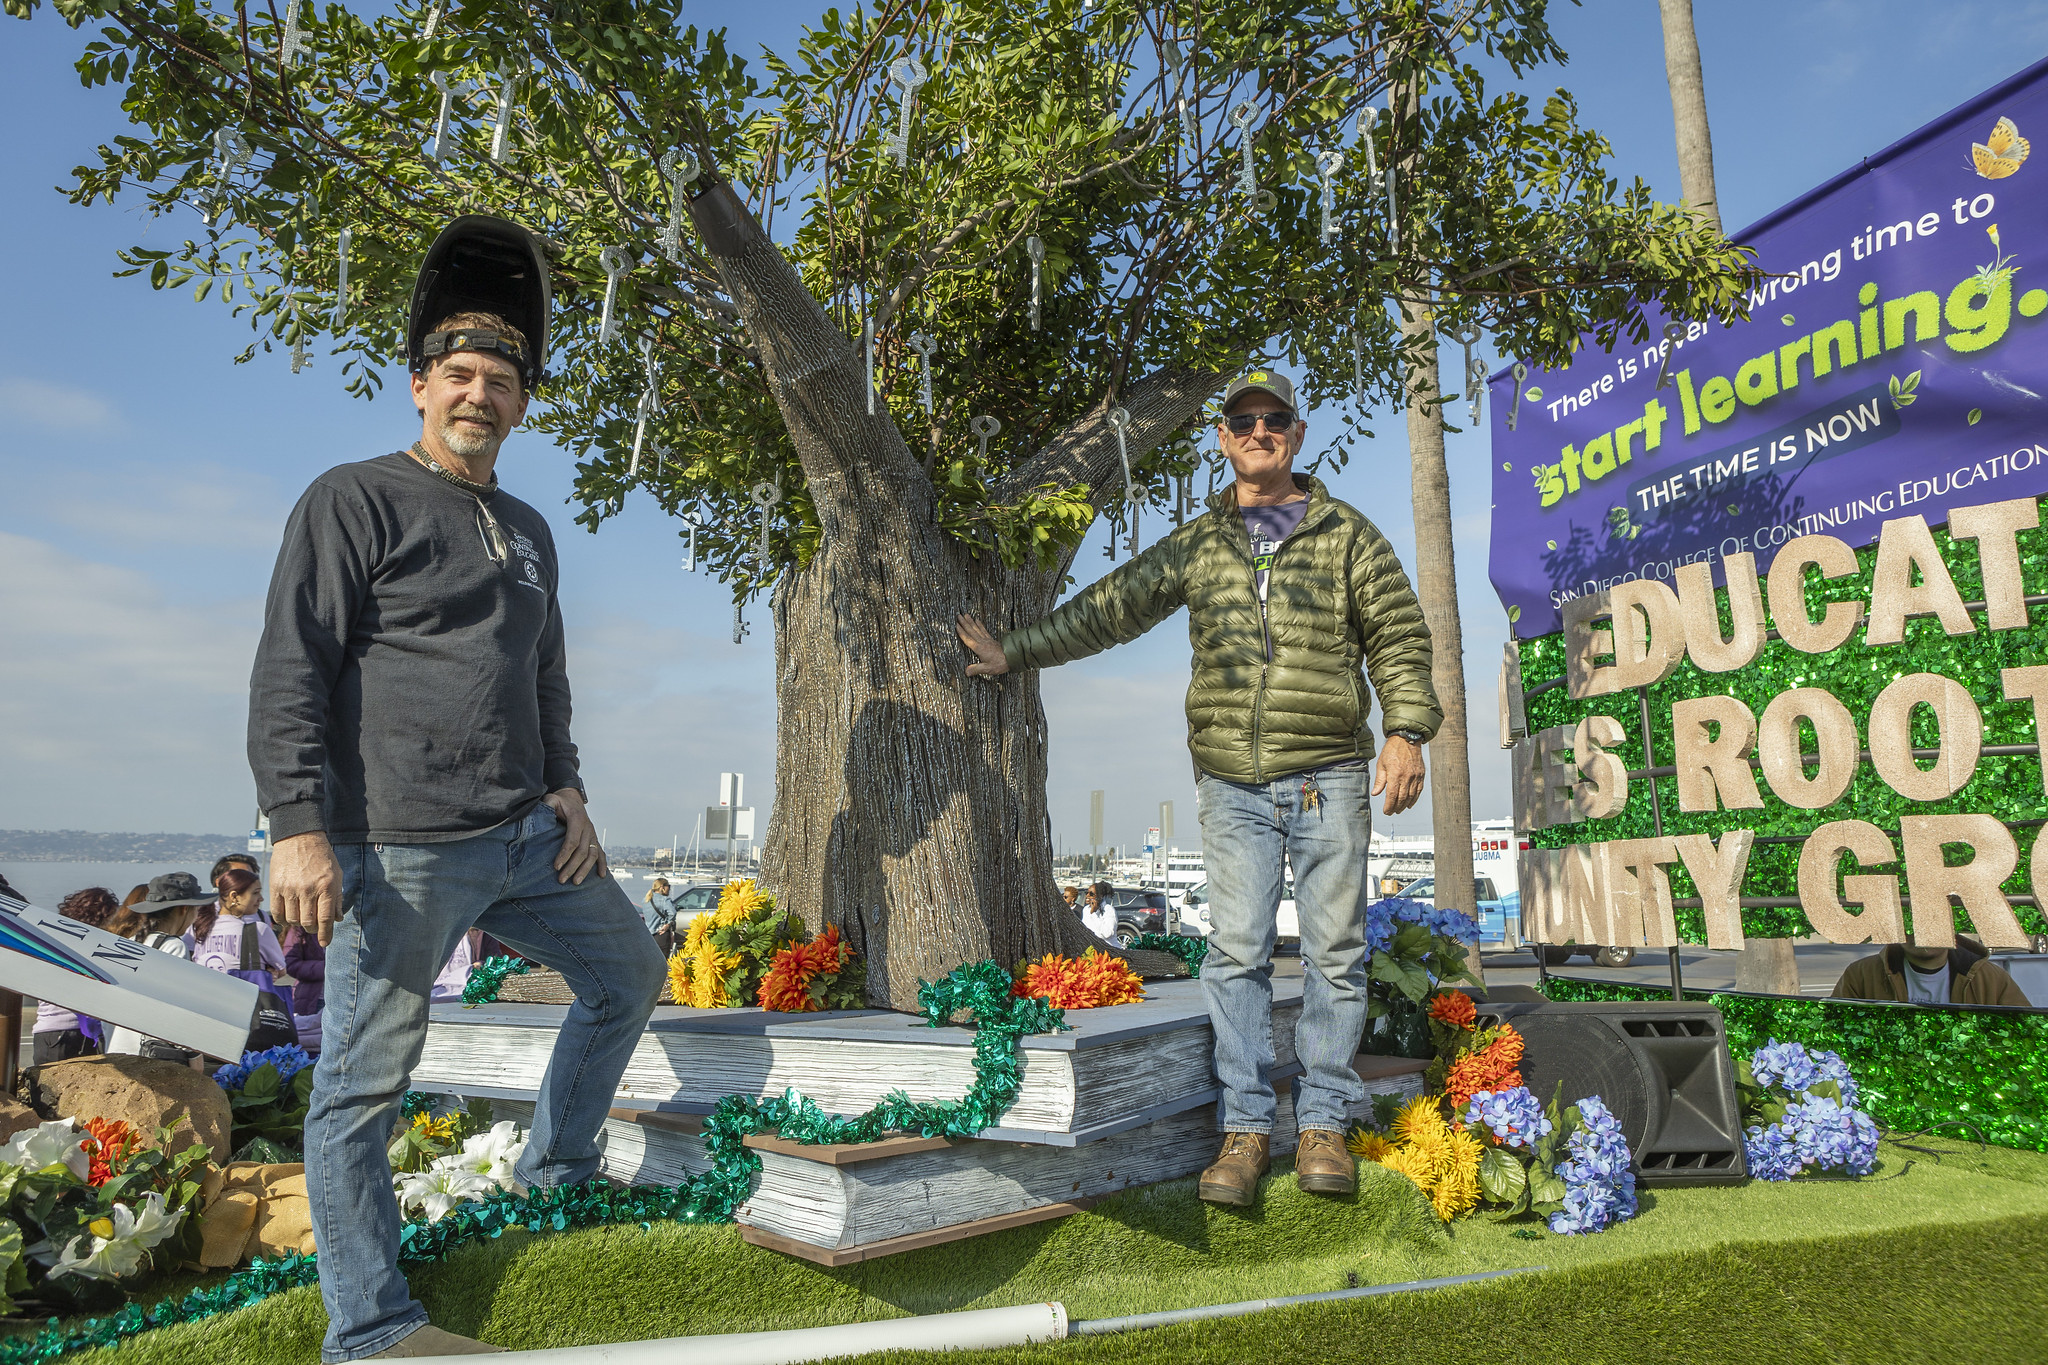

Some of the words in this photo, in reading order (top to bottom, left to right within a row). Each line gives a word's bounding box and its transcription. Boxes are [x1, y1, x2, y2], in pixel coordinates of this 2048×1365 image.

[1541, 397, 1668, 508] start
[1676, 268, 2048, 437] learning.
[1546, 374, 1614, 422] There
[1617, 358, 1638, 383] is
[1741, 248, 1842, 312] wrong
[1851, 212, 1940, 261] time
[1951, 193, 1995, 225] to
[1636, 474, 1687, 512] THE
[1689, 447, 1760, 491] TIME
[1769, 435, 1797, 465] IS
[1805, 397, 1882, 453] NOW
[1797, 813, 2048, 951] GR
